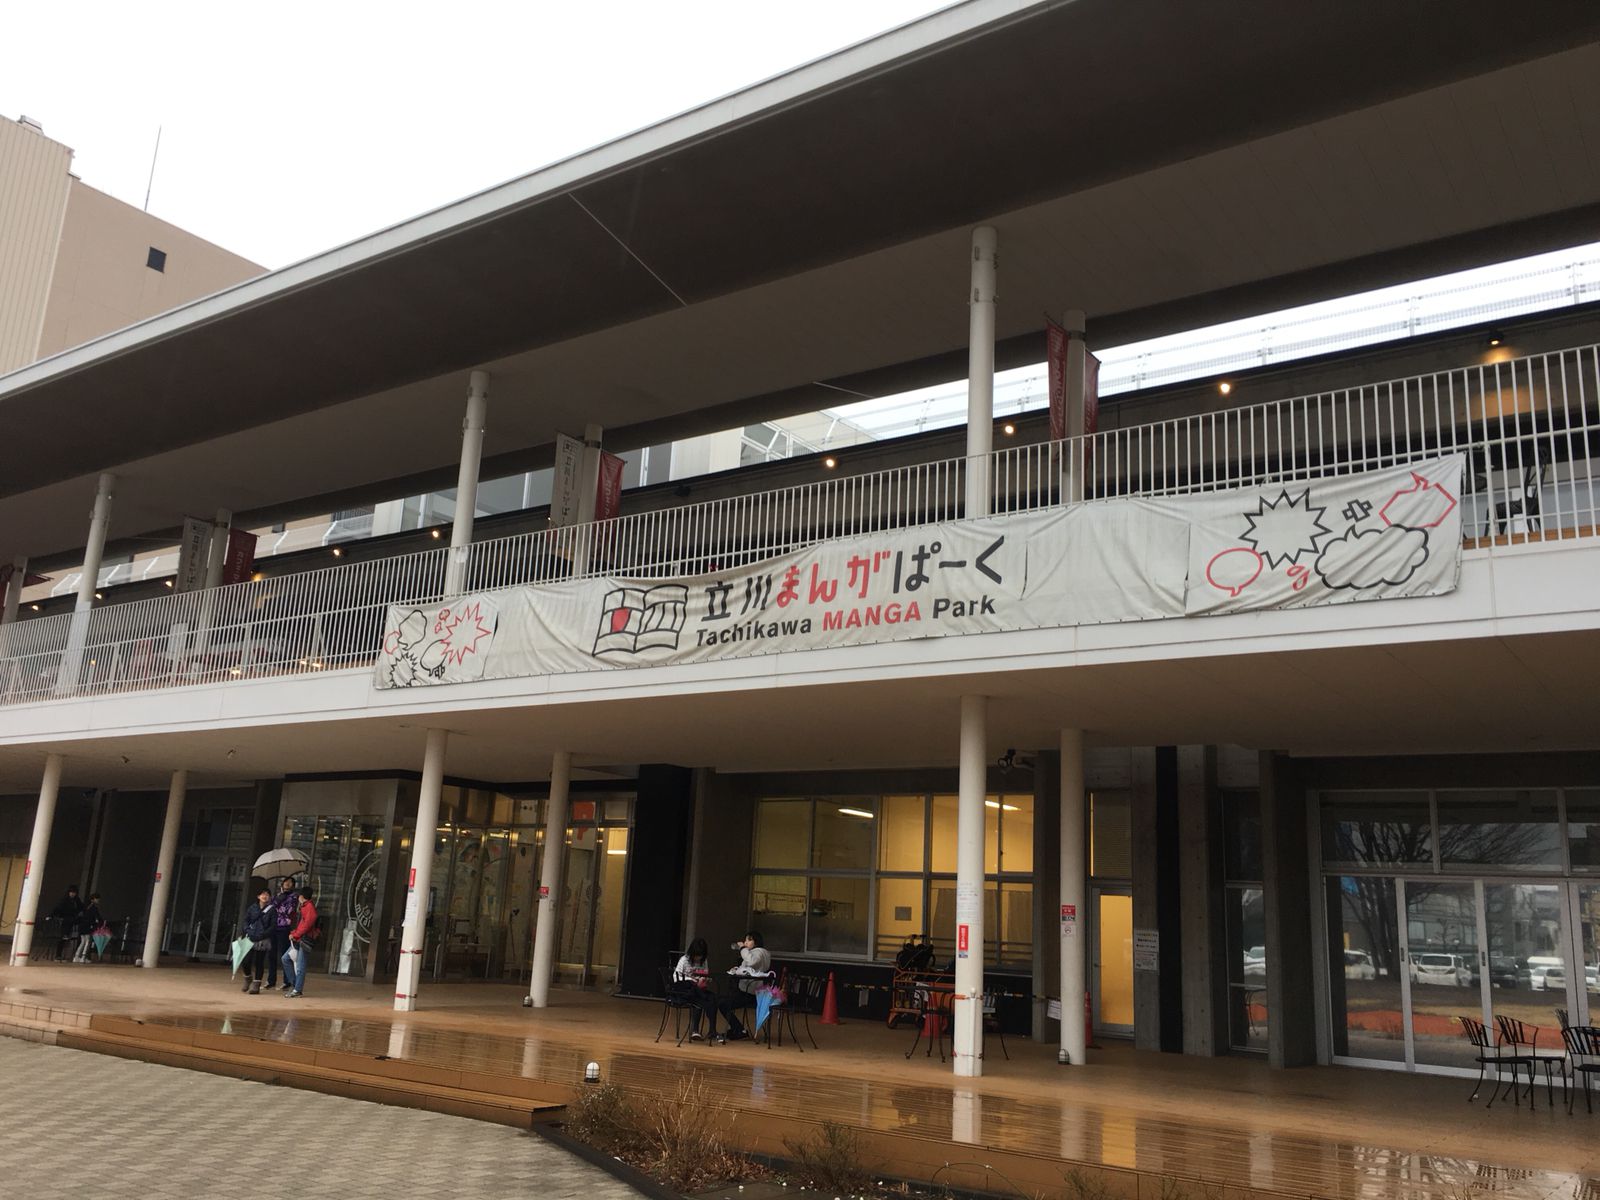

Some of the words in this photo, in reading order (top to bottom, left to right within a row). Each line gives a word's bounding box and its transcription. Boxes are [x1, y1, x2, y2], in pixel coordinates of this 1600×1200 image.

[701, 535, 1005, 621] 立川まんがぱーく
[696, 618, 812, 647] Tachikawa
[823, 601, 921, 631] MANGA
[932, 595, 996, 619] Park
